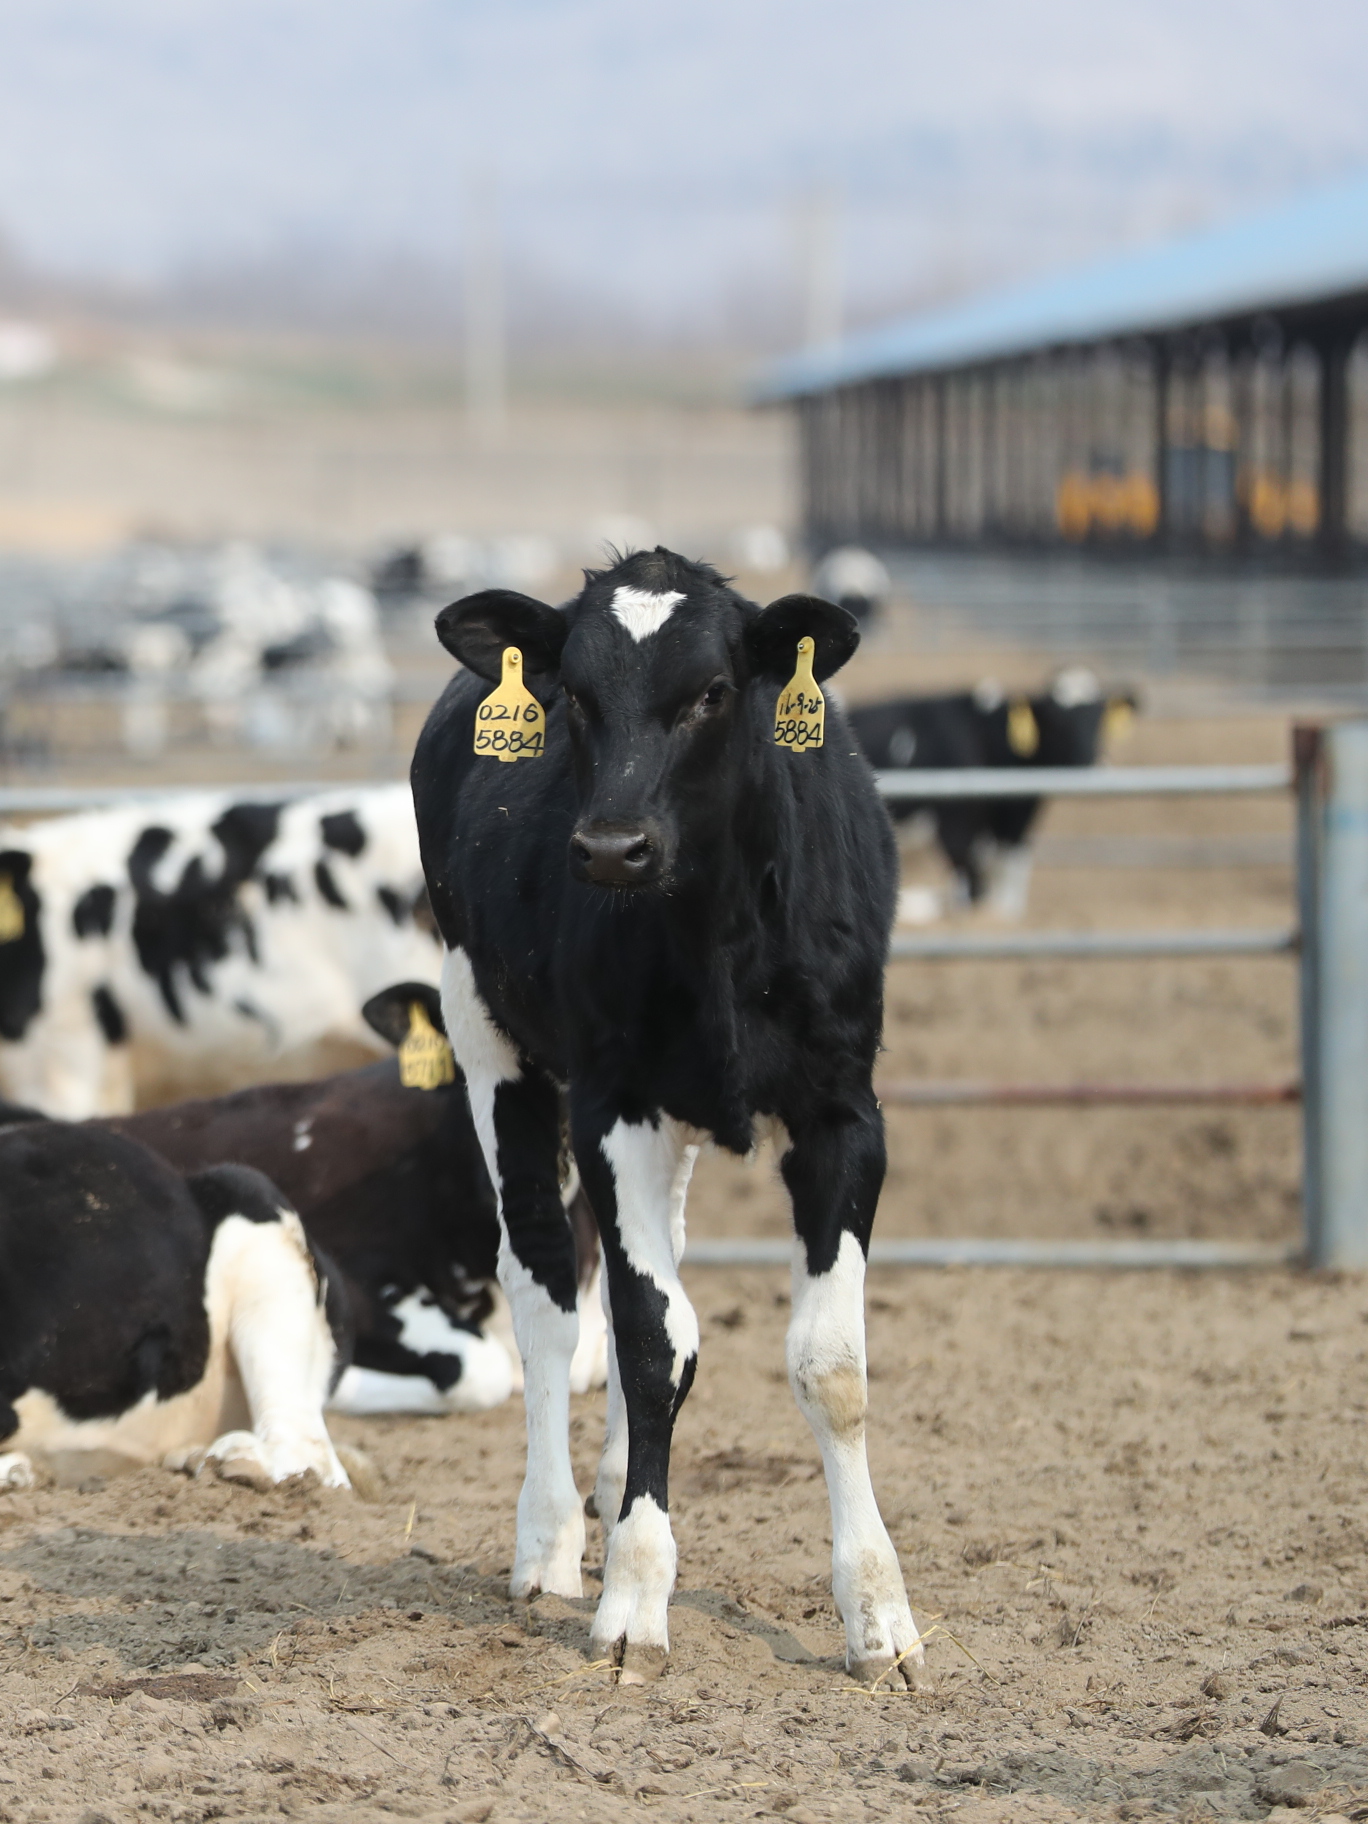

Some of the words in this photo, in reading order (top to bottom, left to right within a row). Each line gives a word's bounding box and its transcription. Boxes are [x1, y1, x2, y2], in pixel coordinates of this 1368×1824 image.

[479, 703, 539, 722] 0216
[475, 729, 545, 756] 5884
[775, 719, 822, 747] 5884
